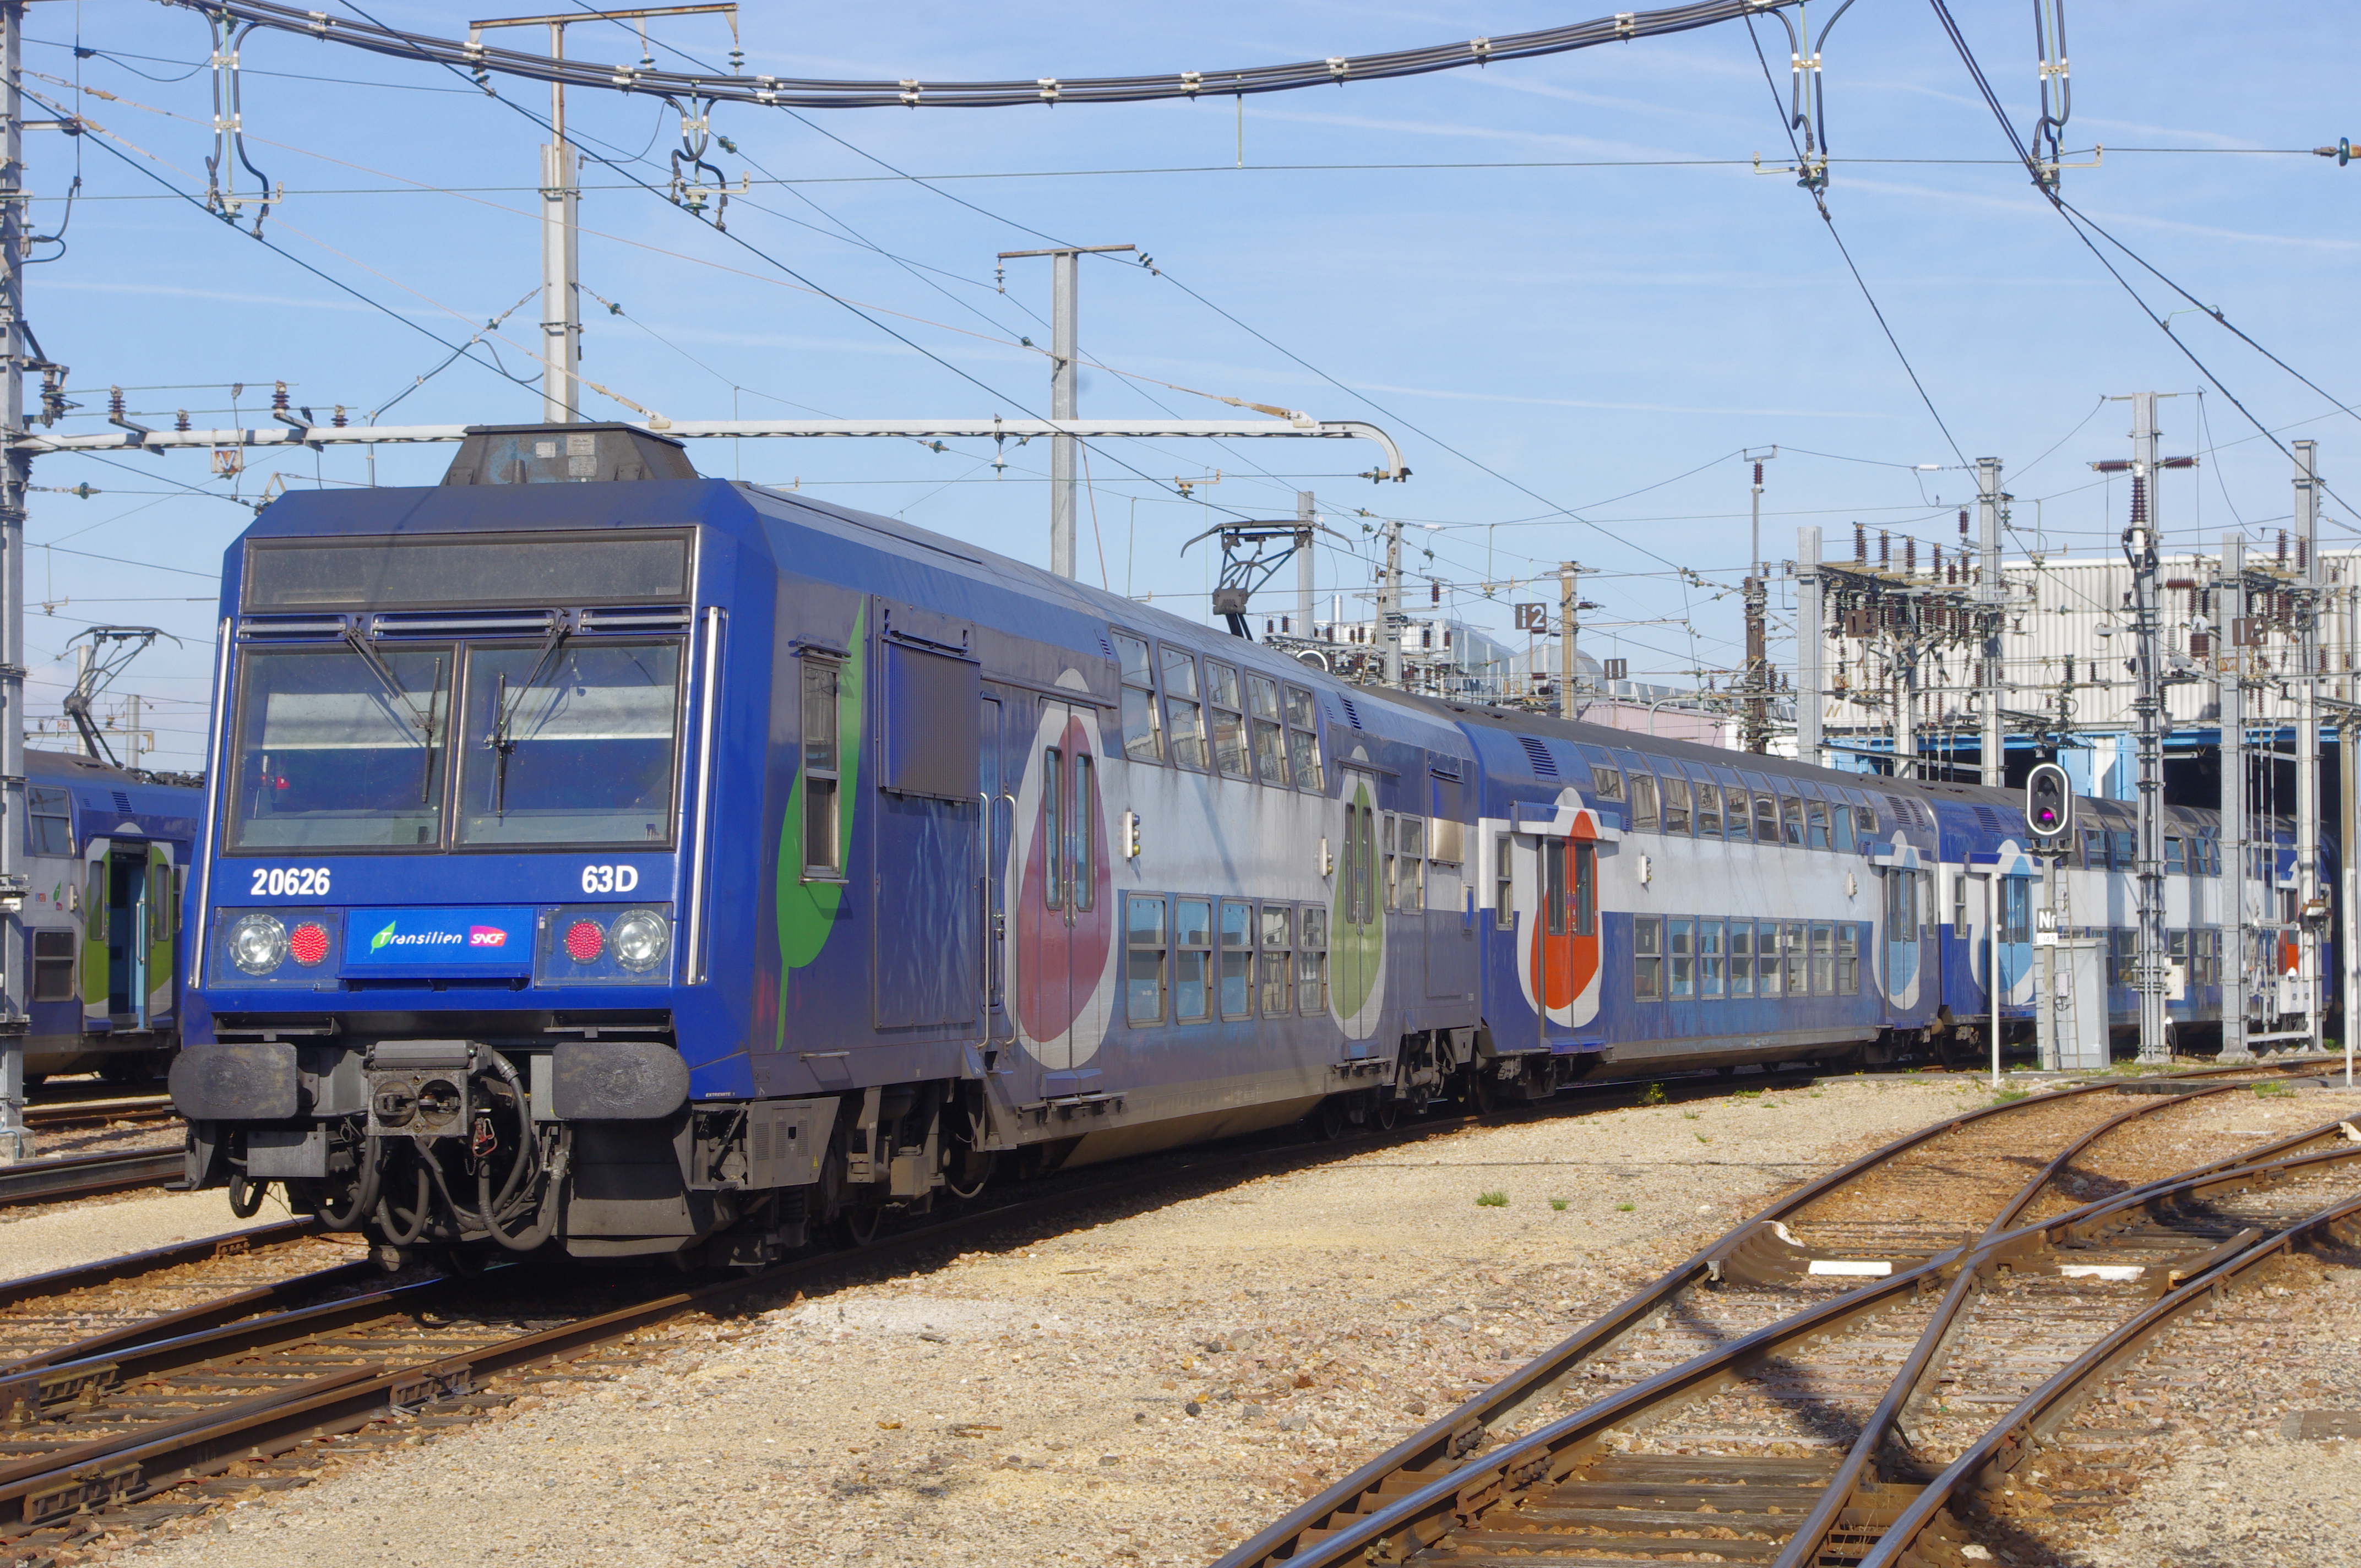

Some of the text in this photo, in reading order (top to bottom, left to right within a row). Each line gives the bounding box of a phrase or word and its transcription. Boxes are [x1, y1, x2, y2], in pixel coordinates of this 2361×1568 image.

[219, 452, 236, 470] V
[1522, 605, 1545, 628] 12
[1852, 612, 1876, 637] 13
[2240, 619, 2266, 644] 14
[251, 867, 330, 896] 20626
[581, 865, 639, 894] 63D
[2039, 911, 2057, 929] Nf
[380, 931, 505, 944] Transilien SNCF
